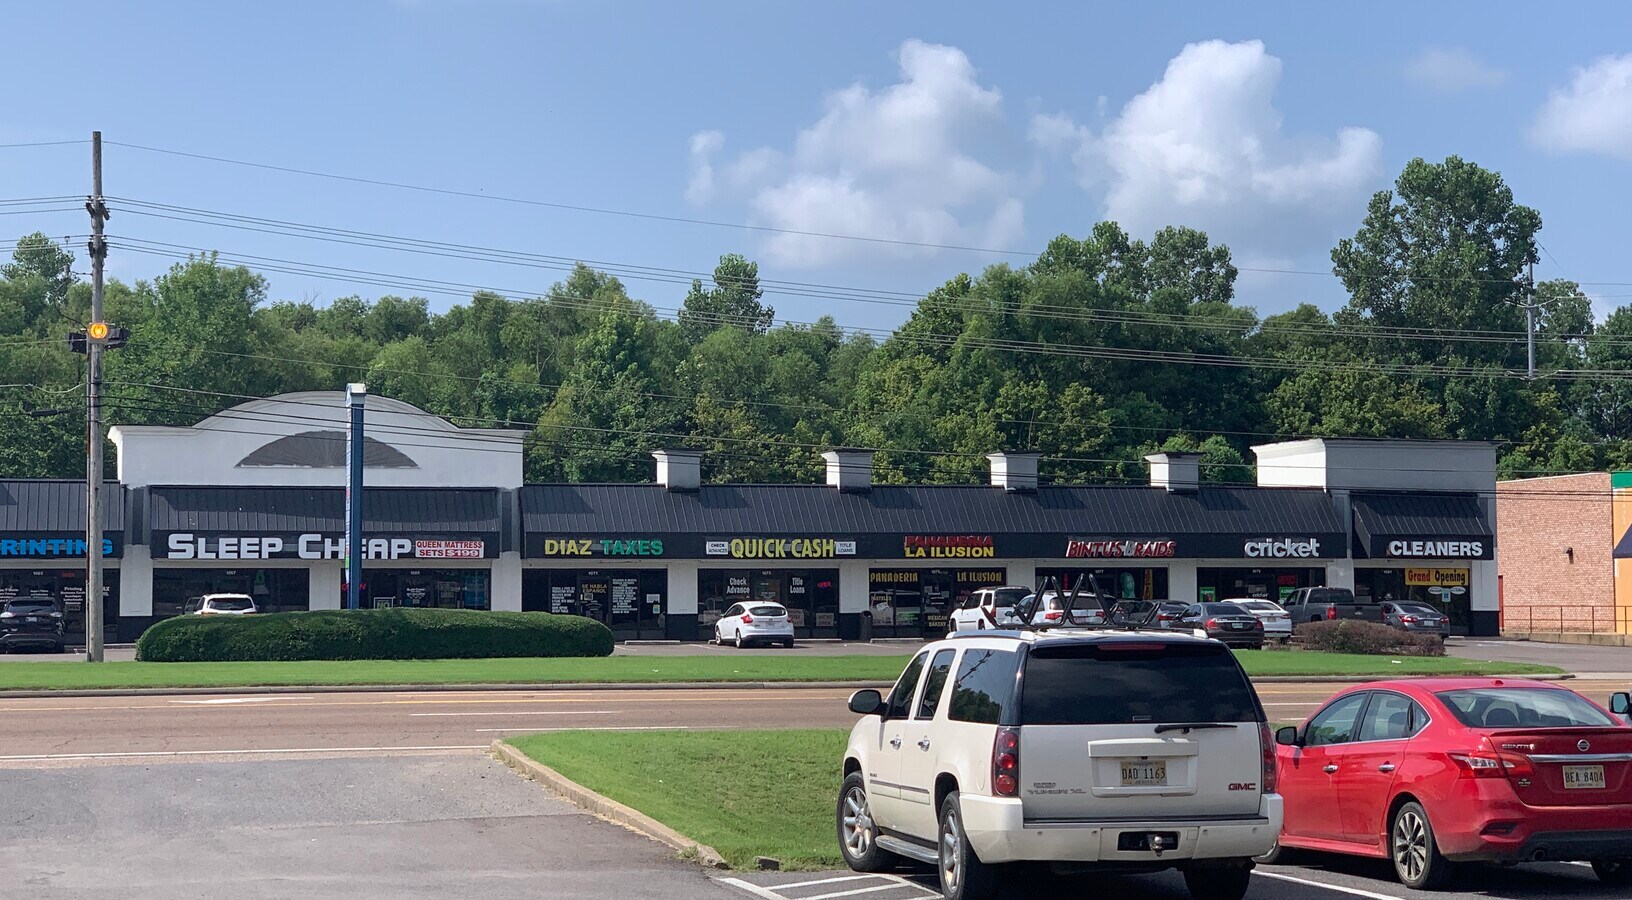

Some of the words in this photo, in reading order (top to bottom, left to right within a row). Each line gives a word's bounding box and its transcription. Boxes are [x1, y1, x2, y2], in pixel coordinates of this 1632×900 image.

[168, 533, 283, 559] SLEEP
[298, 533, 412, 560] CHAP
[416, 541, 442, 549] QUEEN
[444, 541, 483, 549] MATTRESS
[544, 539, 592, 555] DIAZ
[599, 539, 663, 555] TAXES
[731, 538, 786, 559] QUICK
[791, 538, 834, 558] CASH
[1245, 538, 1320, 557] cricket
[1389, 541, 1483, 556] CLEANERS
[419, 549, 444, 557] SETS
[905, 546, 926, 557] LA
[930, 546, 994, 557] ILUSION
[729, 577, 747, 586] Check
[792, 577, 803, 586] Title
[870, 572, 918, 583] PANADERIA
[957, 572, 966, 582] LA
[969, 572, 1002, 582] ILUSION
[1408, 570, 1430, 582] Grand
[1435, 569, 1465, 585] Opening
[726, 586, 750, 594] Advance
[789, 585, 805, 594] Loans
[1144, 767, 1166, 779] 1163
[1583, 772, 1604, 782] 8404
[1228, 783, 1256, 791] GMC
